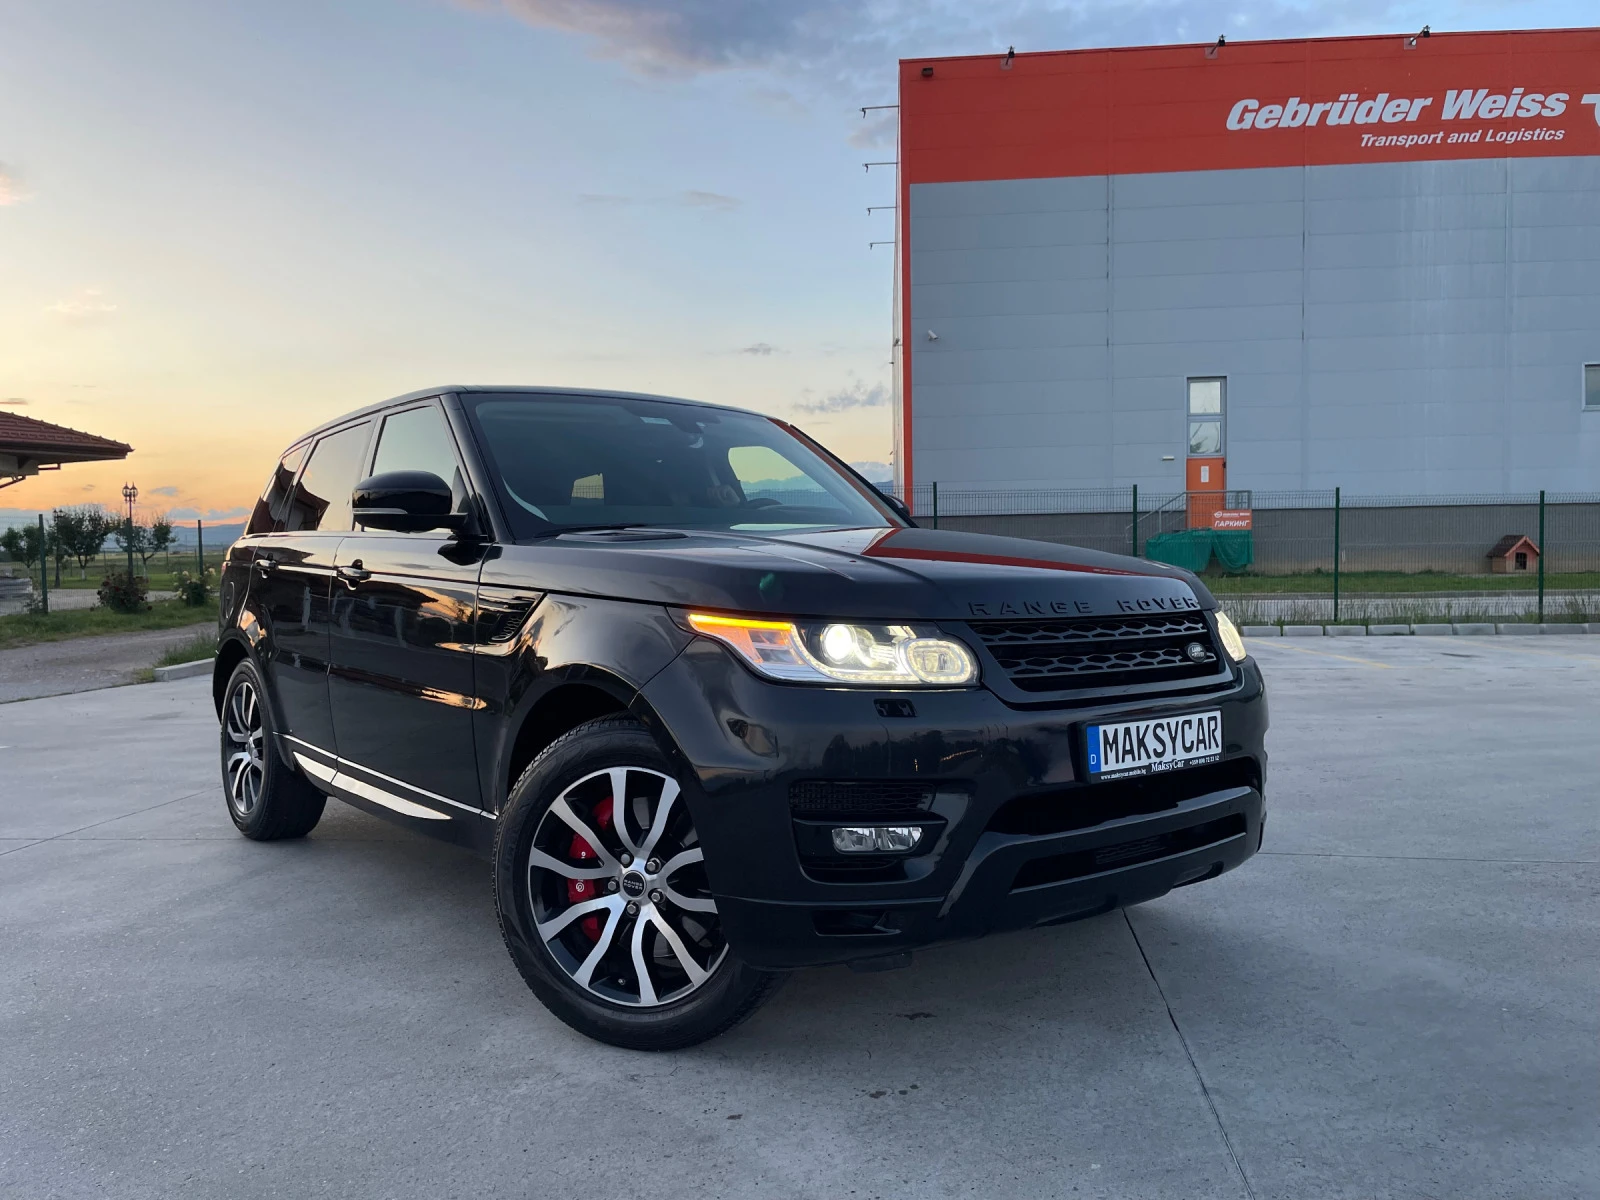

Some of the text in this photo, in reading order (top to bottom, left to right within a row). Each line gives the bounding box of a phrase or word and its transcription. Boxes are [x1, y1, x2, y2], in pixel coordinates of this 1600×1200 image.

[1226, 87, 1569, 130] Gebrüder Weiss
[1361, 128, 1565, 148] Transport and Logistics
[968, 596, 1199, 616] RANGE ROVER
[1102, 716, 1219, 765] MAKSYCAR
[1090, 754, 1097, 765] D
[1151, 759, 1185, 772] MaksyCar
